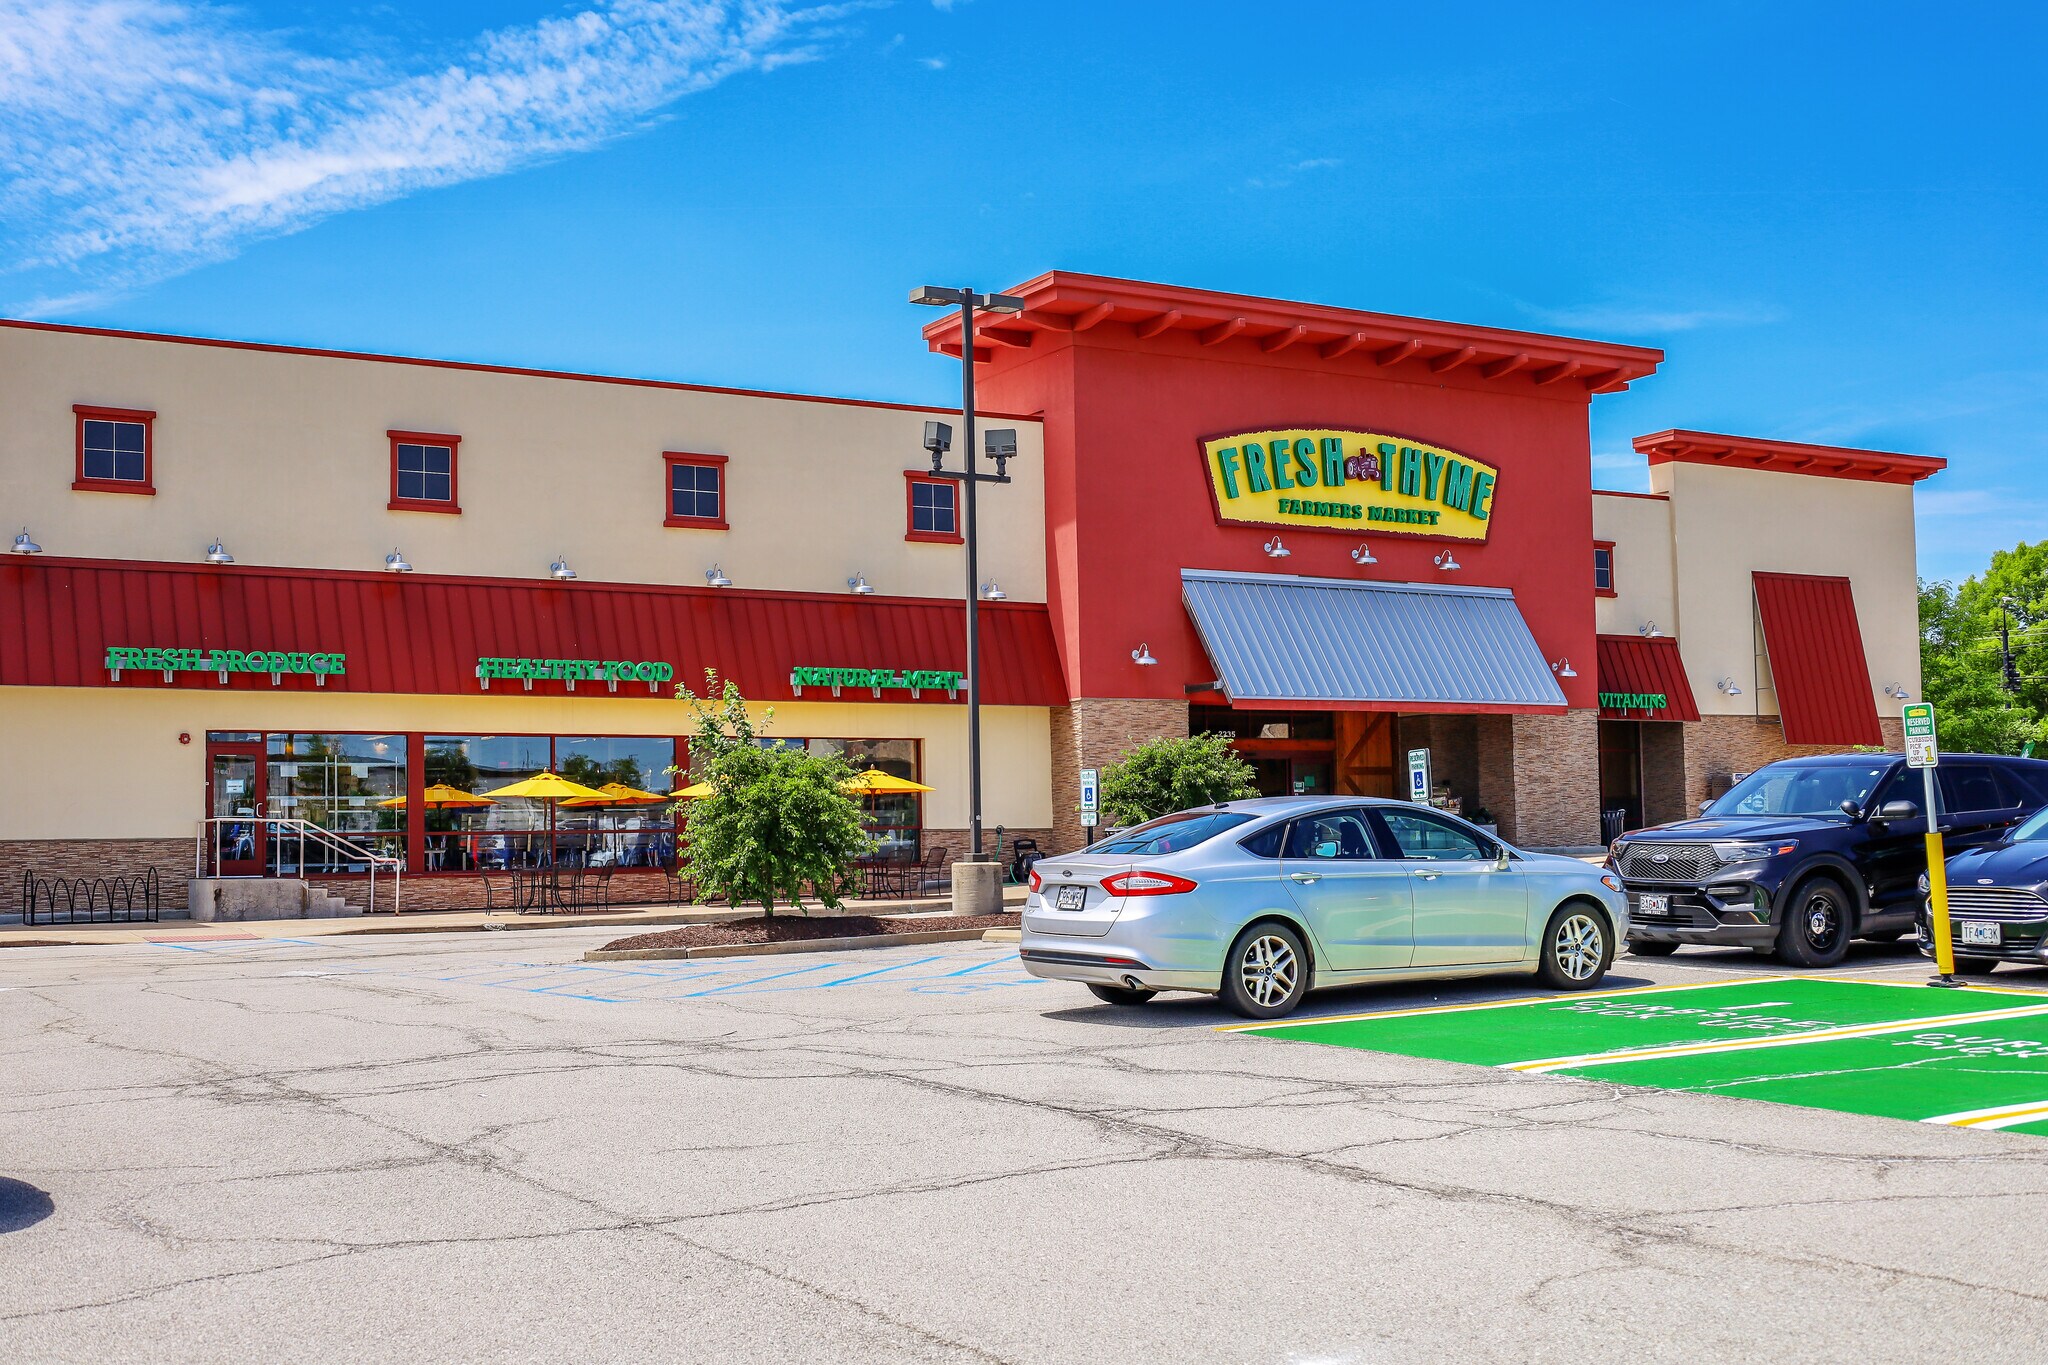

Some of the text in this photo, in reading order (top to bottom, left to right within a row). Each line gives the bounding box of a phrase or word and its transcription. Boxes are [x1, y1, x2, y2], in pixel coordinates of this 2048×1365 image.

[1217, 437, 1496, 520] FRESH THYME
[1278, 498, 1441, 525] FARMERS MARKET
[106, 647, 346, 675] FRESH PRODUCE
[478, 657, 674, 682] HEALTHY FOOD
[793, 666, 963, 690] NATURAL MEAT
[1599, 692, 1667, 709] VITAMINS
[1907, 717, 1931, 726] RESERVED
[1909, 726, 1930, 735] PARKING
[1924, 745, 1934, 762] 1
[1963, 926, 1998, 939] TF4 C3K
[1549, 1005, 1674, 1019] PICK
[1575, 1001, 1836, 1027] CURBSIDE
[1698, 1019, 1775, 1028] UP
[1912, 1033, 2048, 1050] CUR
